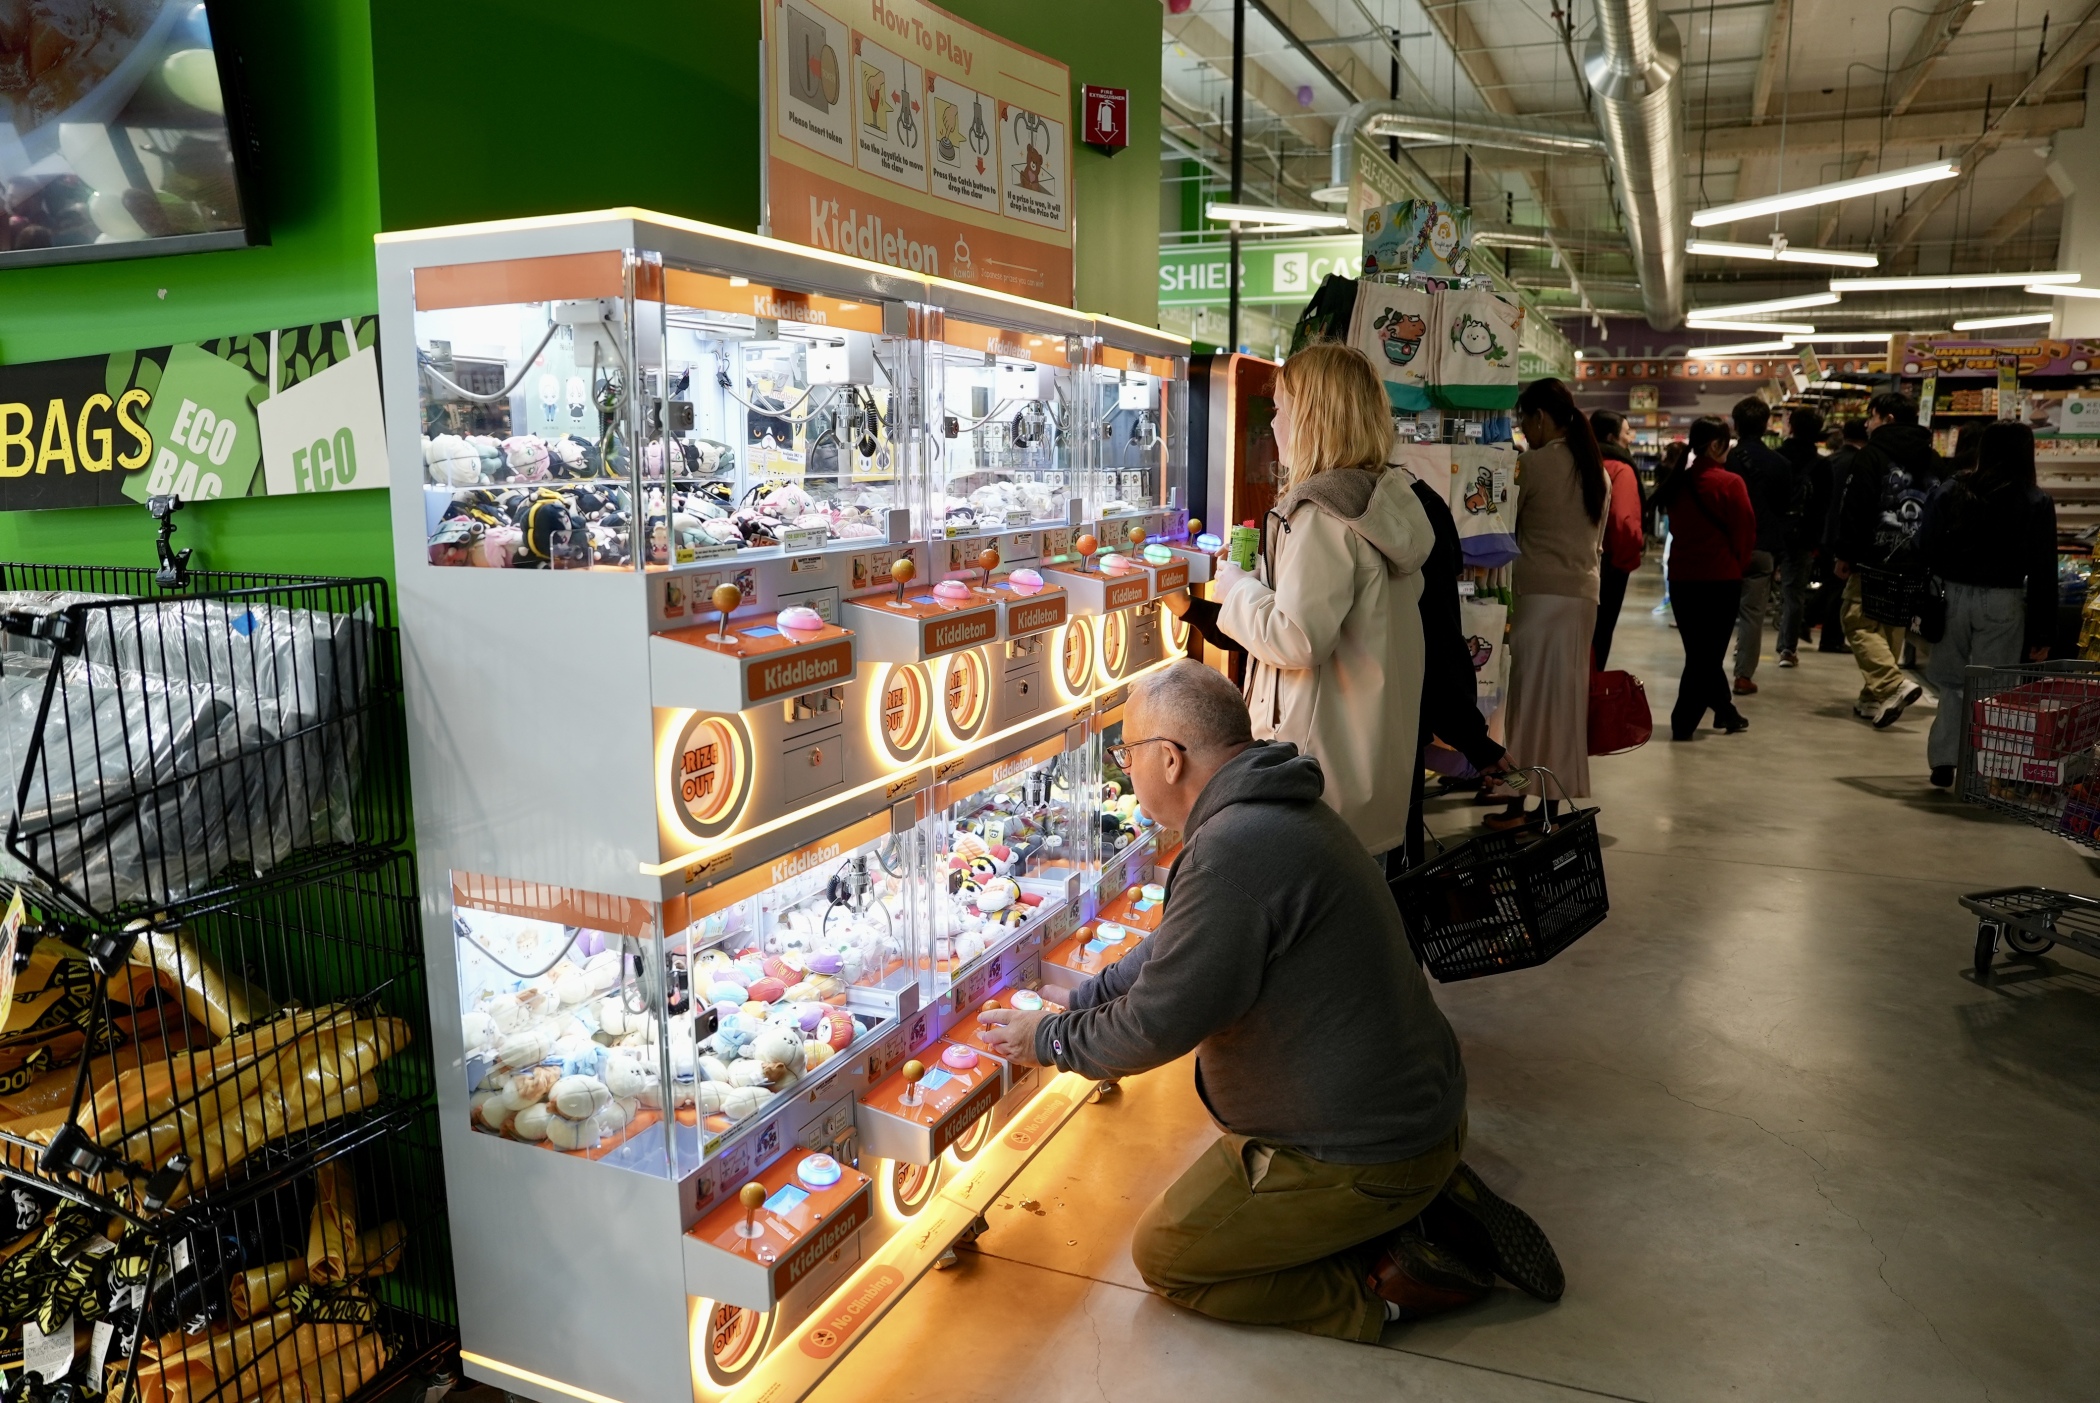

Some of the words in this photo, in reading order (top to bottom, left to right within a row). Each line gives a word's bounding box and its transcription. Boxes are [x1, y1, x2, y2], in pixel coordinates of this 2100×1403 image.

[871, 0, 910, 39] How
[911, 17, 933, 51] To
[935, 30, 973, 76] Play
[1088, 92, 1126, 101] EXTINGUISHER
[788, 111, 809, 130] Please
[808, 120, 826, 138] insert
[826, 129, 843, 145] token
[860, 138, 871, 152] Use
[871, 142, 881, 156] the
[881, 146, 902, 164] Joystick
[903, 156, 909, 166] to
[909, 160, 924, 172] move
[881, 157, 891, 170] the
[891, 164, 904, 174] claw
[933, 167, 948, 182] Press
[948, 171, 957, 184] the
[957, 174, 972, 190] Catch
[972, 179, 991, 194] button
[990, 185, 997, 195] to
[948, 182, 961, 197] drop
[961, 186, 971, 197] the
[970, 189, 983, 200] claw
[1010, 201, 1022, 213] drop
[1022, 204, 1028, 213] in
[1028, 206, 1037, 217] the
[1037, 207, 1049, 220] Prize
[1049, 210, 1060, 221] Out
[1016, 193, 1030, 207] prize
[1030, 196, 1035, 207] is
[1047, 201, 1052, 210] it
[1052, 202, 1061, 213] will
[810, 195, 939, 277] Kiddleton
[953, 266, 975, 280] Kawaii
[981, 268, 1003, 283] Japanese
[1003, 274, 1018, 285] prizes
[1017, 277, 1026, 287] you
[1026, 279, 1035, 287] can
[754, 292, 828, 325] Kiddleton
[987, 336, 1032, 360] Kiddleton
[1935, 347, 1994, 357] JAPANESE
[0, 389, 153, 478] BAGS
[170, 398, 237, 466] ECO
[292, 427, 357, 493] ECO
[1161, 573, 1184, 588] Kiddleton
[1112, 587, 1143, 606] Kiddleton
[1018, 608, 1058, 630] Kiddleton
[936, 622, 987, 647] Kiddleton
[764, 657, 838, 691] Kiddleton
[993, 756, 1033, 784] Kiddleton
[682, 771, 715, 803] OUT
[771, 842, 840, 885] Kiddleton
[944, 1092, 993, 1144] Kiddleton
[1024, 1122, 1040, 1134] No
[1033, 1099, 1065, 1124] Climbing
[789, 1210, 856, 1283] Kiddleton
[830, 1314, 853, 1331] No
[846, 1275, 894, 1315] Climbing
